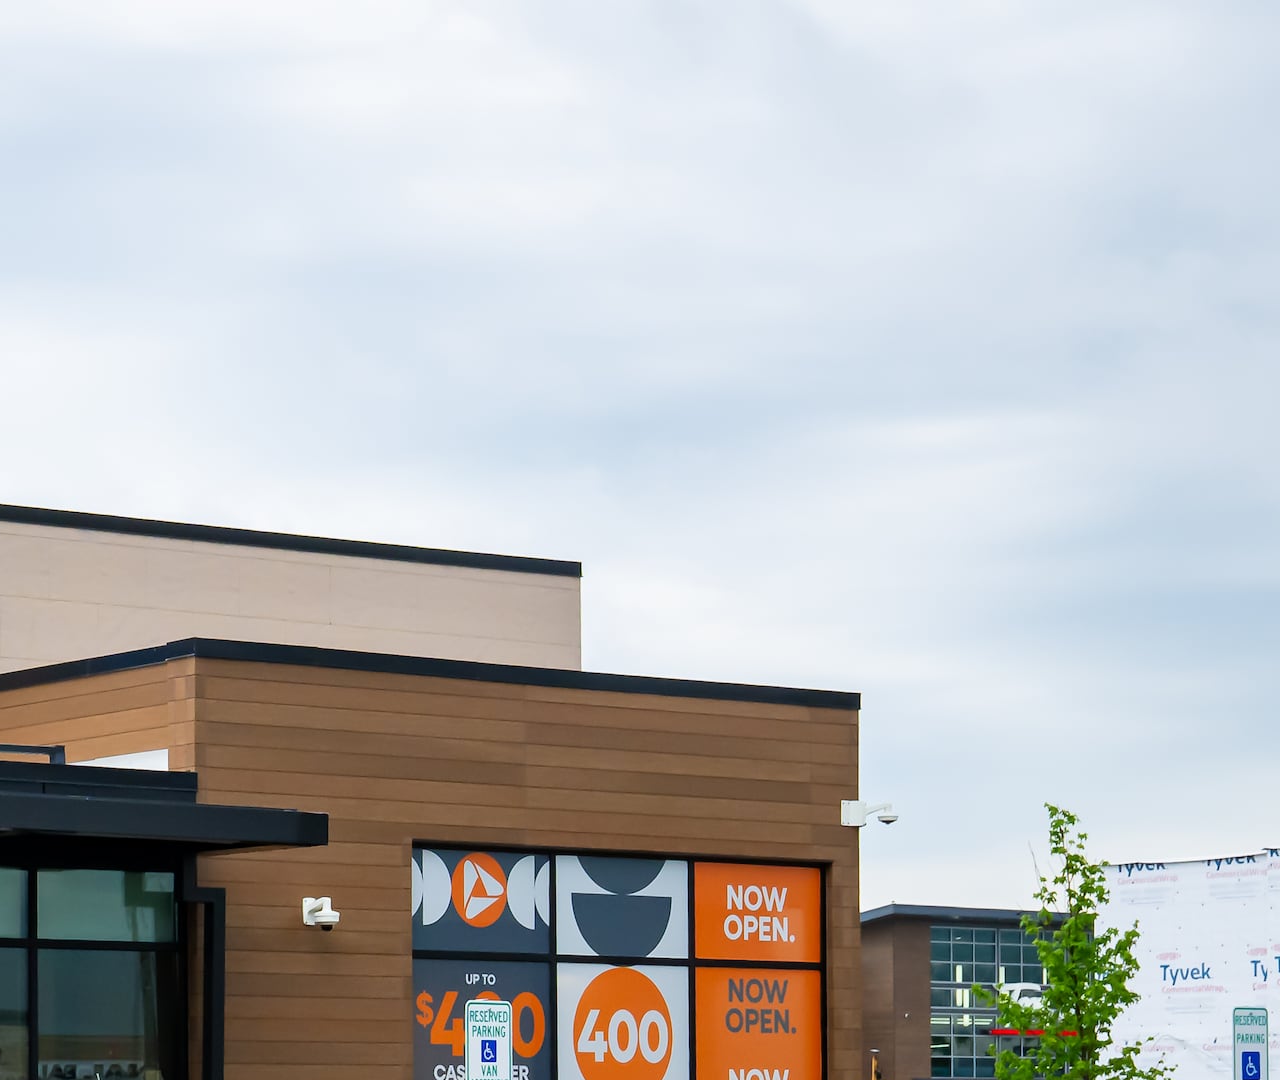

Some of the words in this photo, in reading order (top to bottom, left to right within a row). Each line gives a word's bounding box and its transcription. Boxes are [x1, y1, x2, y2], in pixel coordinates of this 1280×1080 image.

[726, 884, 788, 913] NOW
[723, 914, 796, 943] OPEN.
[465, 973, 480, 985] UP
[481, 974, 496, 986] TO
[1160, 962, 1211, 986] Tyvek
[728, 978, 788, 1004] NOW
[416, 990, 545, 1058] $40
[470, 1009, 508, 1023] RESERVED
[725, 1007, 797, 1034] OPEN.
[1235, 1015, 1267, 1026] RESERVED
[472, 1025, 506, 1038] PARKING
[577, 1008, 669, 1064] 400
[1236, 1033, 1265, 1044] PARKING
[481, 1065, 498, 1077] VAN
